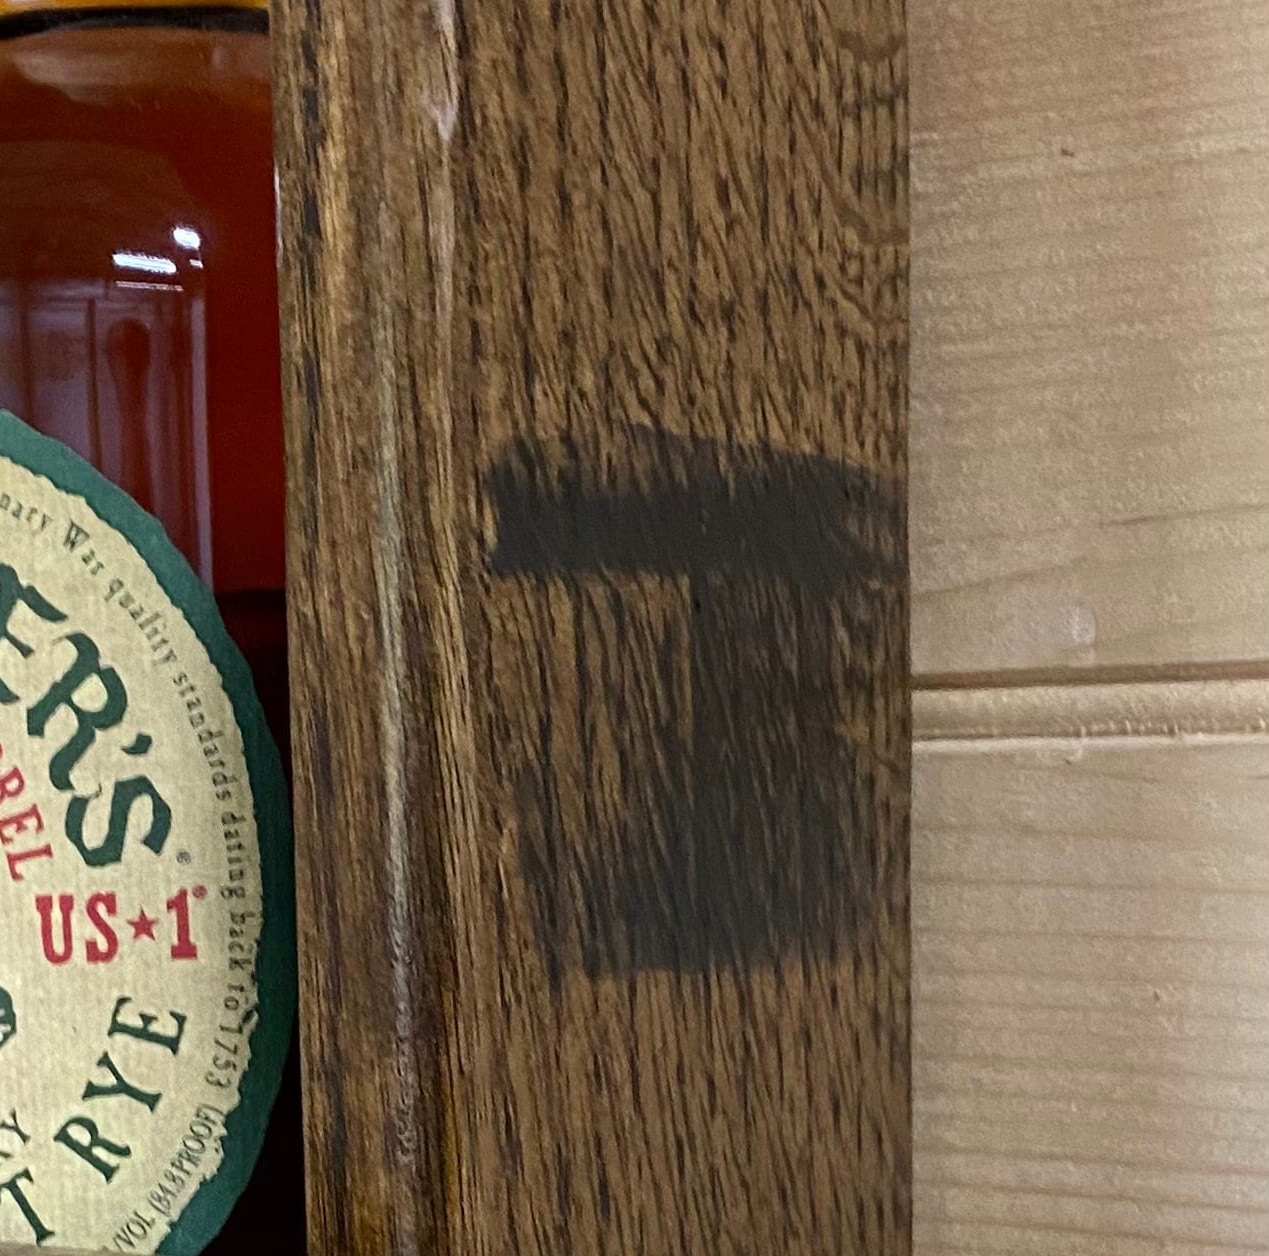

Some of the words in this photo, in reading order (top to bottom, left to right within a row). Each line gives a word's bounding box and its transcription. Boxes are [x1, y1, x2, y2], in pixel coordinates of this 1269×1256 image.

[63, 519, 105, 576] War
[103, 577, 178, 666] quality
[173, 671, 239, 801] standards
[219, 810, 247, 900] dating
[229, 910, 255, 972] back
[224, 983, 245, 1011] to
[53, 996, 187, 1185] RYE
[205, 1023, 243, 1090] 1753
